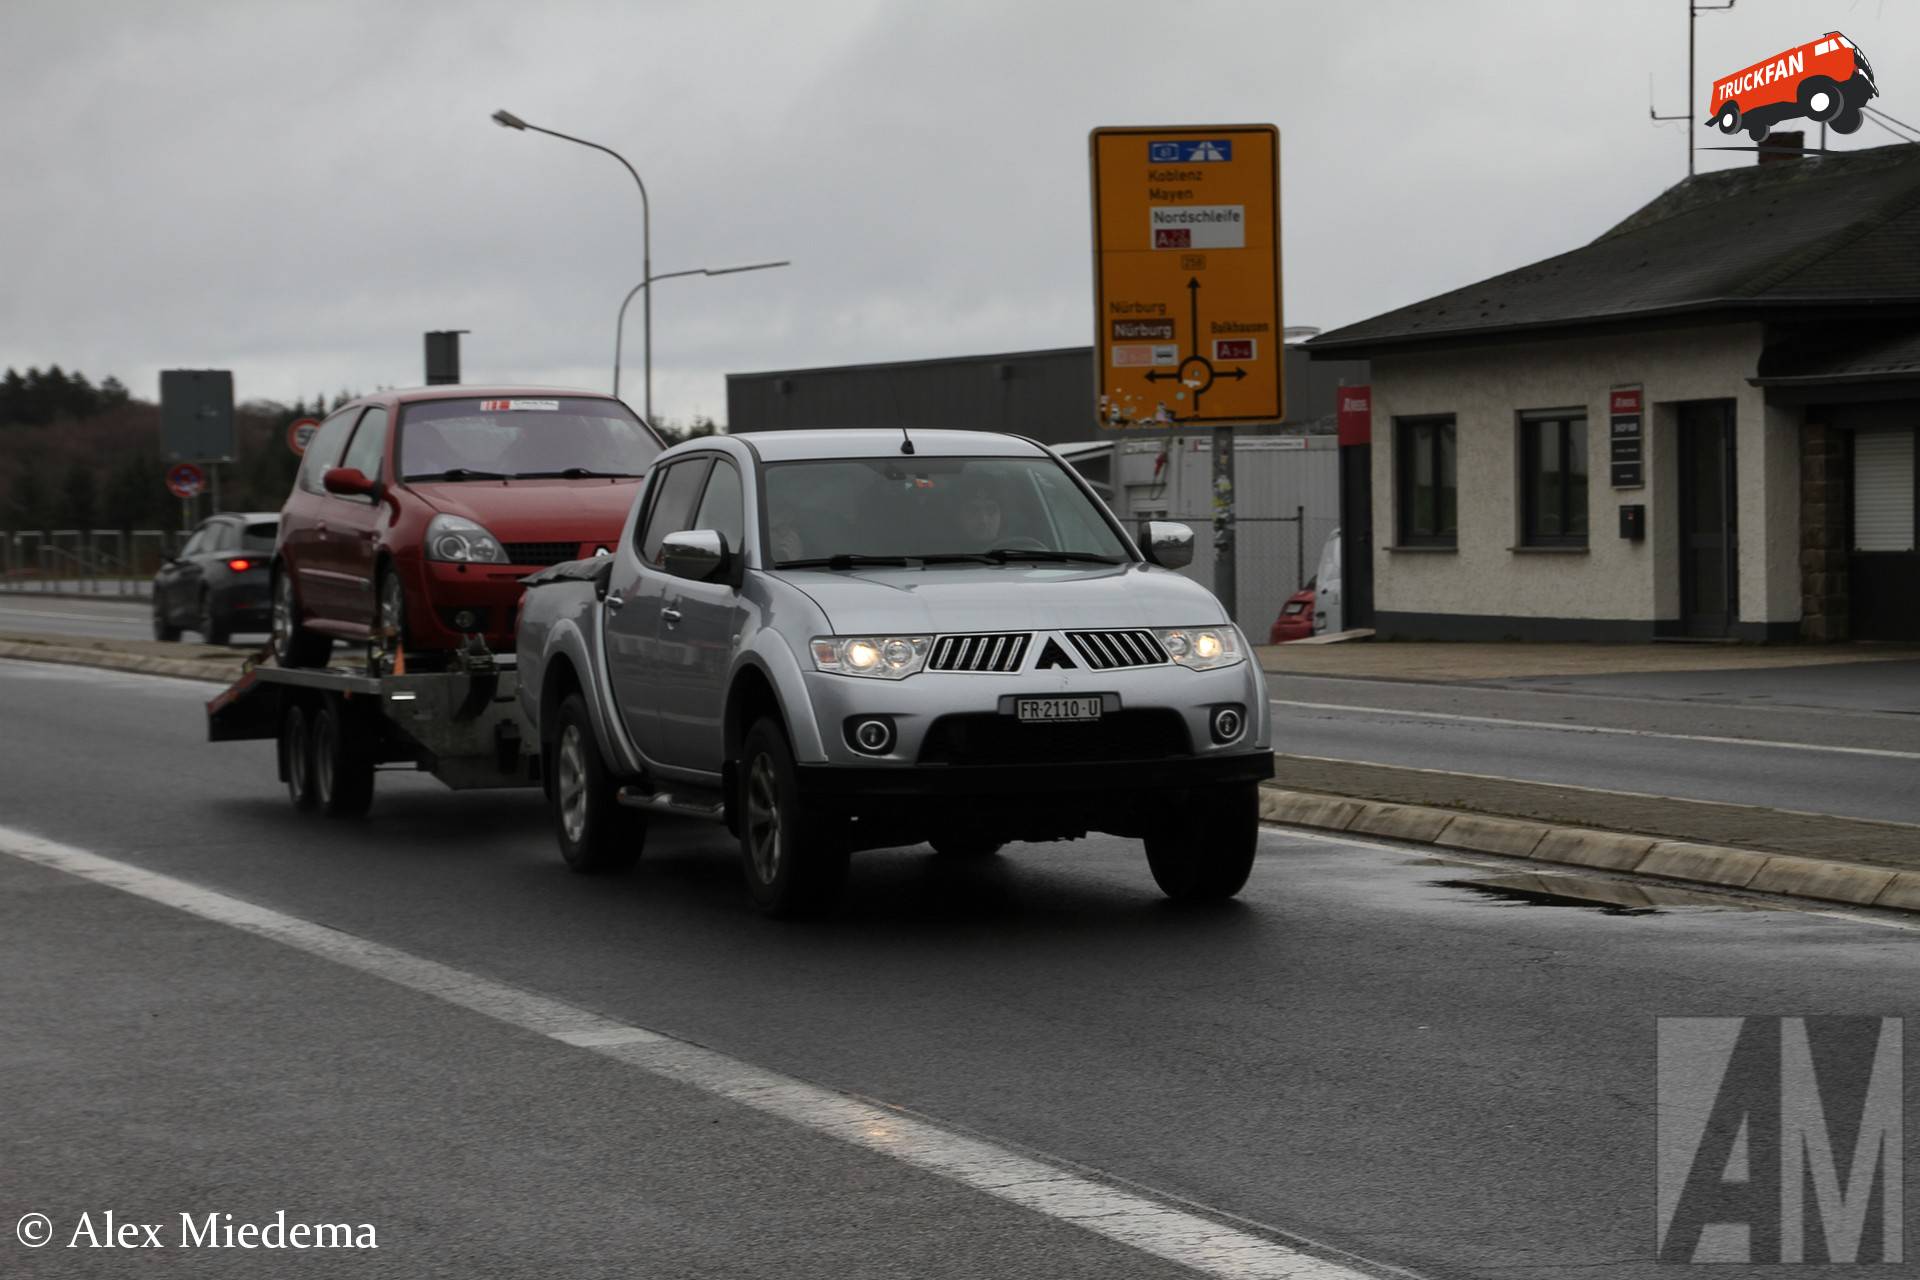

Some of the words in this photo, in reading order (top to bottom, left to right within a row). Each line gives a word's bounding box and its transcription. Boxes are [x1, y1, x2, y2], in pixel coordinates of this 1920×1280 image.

[1148, 169, 1203, 182] Koblenz
[1149, 188, 1194, 203] Mayen
[1154, 209, 1241, 224] Nordschleife
[1114, 322, 1173, 339] Nürburg
